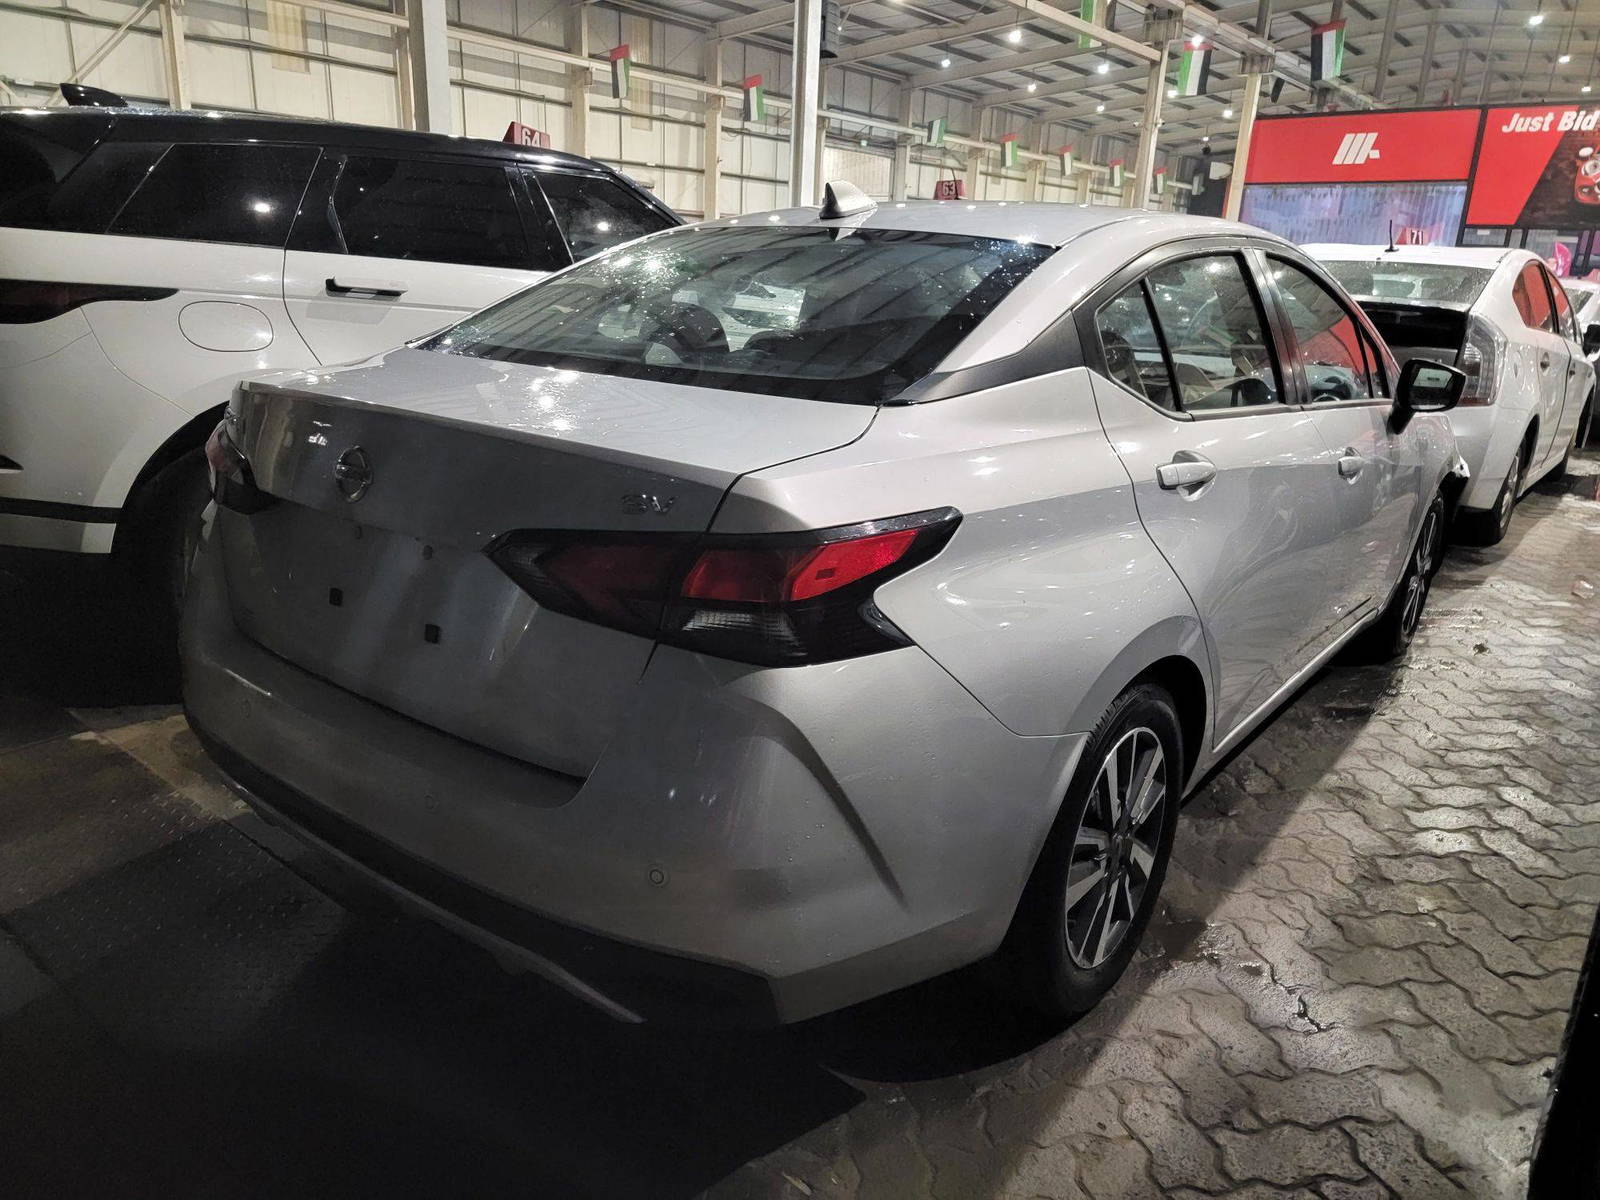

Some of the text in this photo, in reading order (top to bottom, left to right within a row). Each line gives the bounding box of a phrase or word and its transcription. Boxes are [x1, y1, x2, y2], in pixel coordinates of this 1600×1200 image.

[1501, 110, 1600, 133] Just Bid
[522, 127, 541, 147] 64
[943, 181, 956, 195] 63
[1412, 230, 1423, 245] 71
